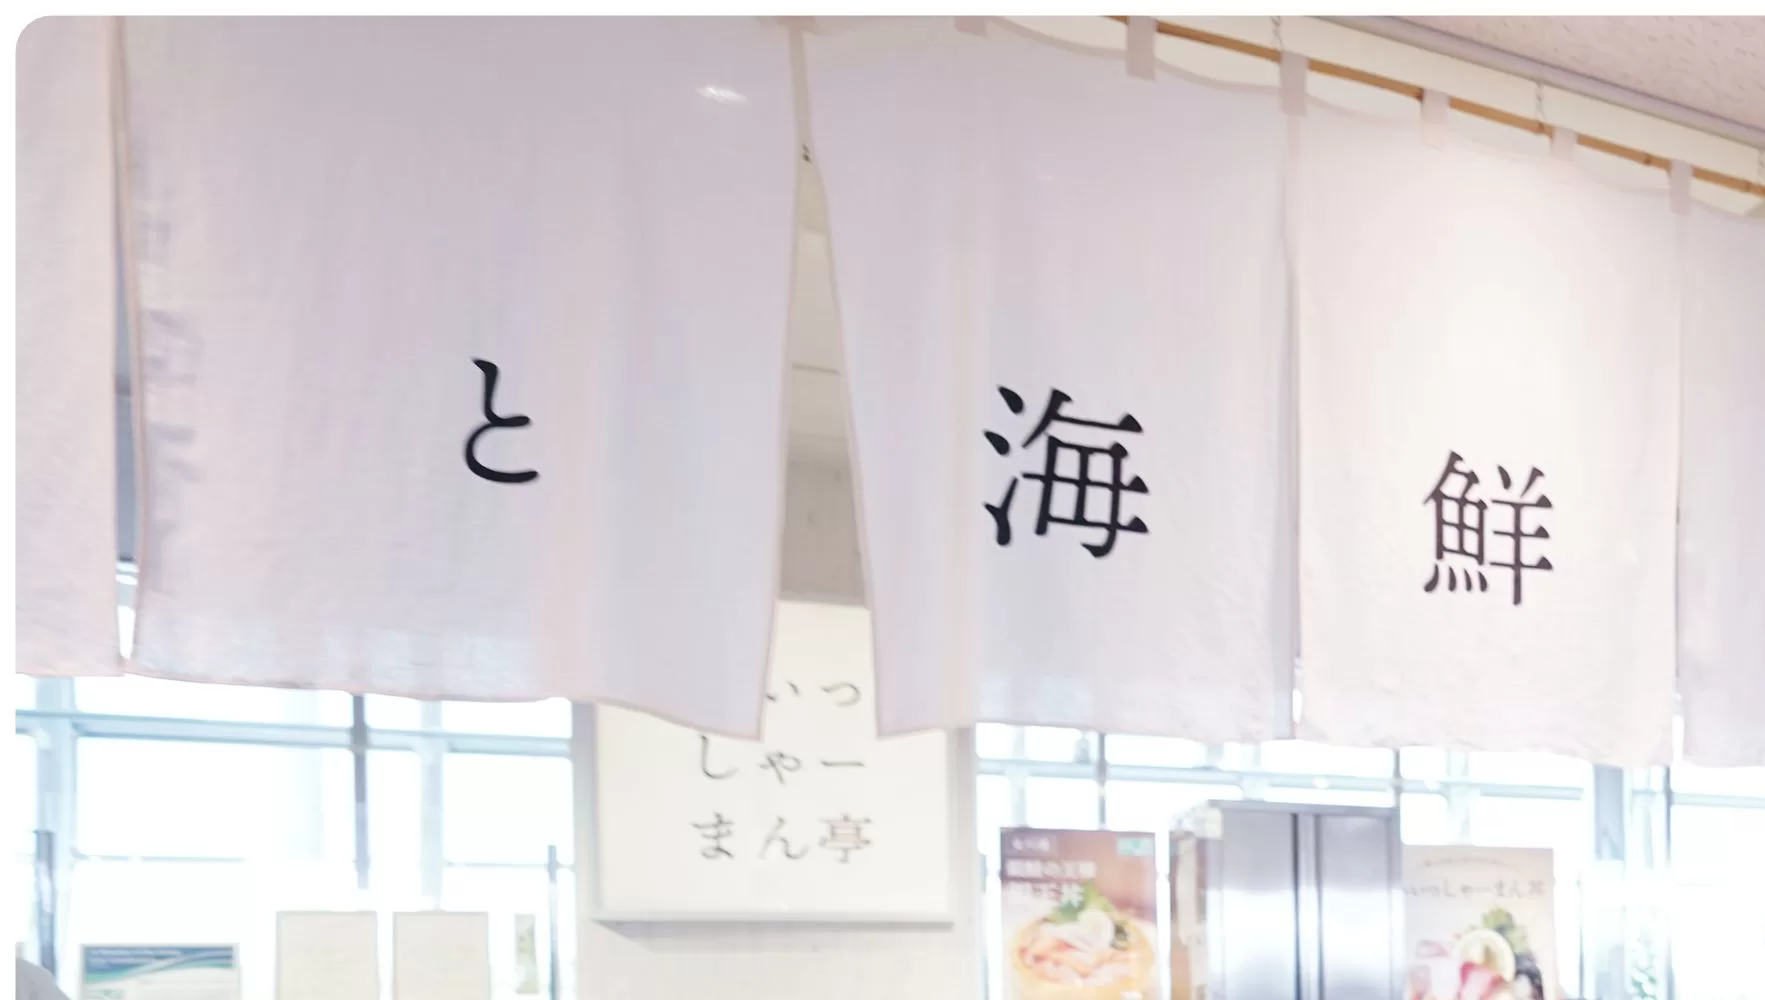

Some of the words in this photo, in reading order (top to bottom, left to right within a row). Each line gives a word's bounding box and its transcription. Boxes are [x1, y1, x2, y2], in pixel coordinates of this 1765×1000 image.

[465, 359, 538, 483] と
[984, 386, 1148, 558] 海
[1425, 452, 1552, 604] 鮮
[690, 812, 873, 863] まん亭
